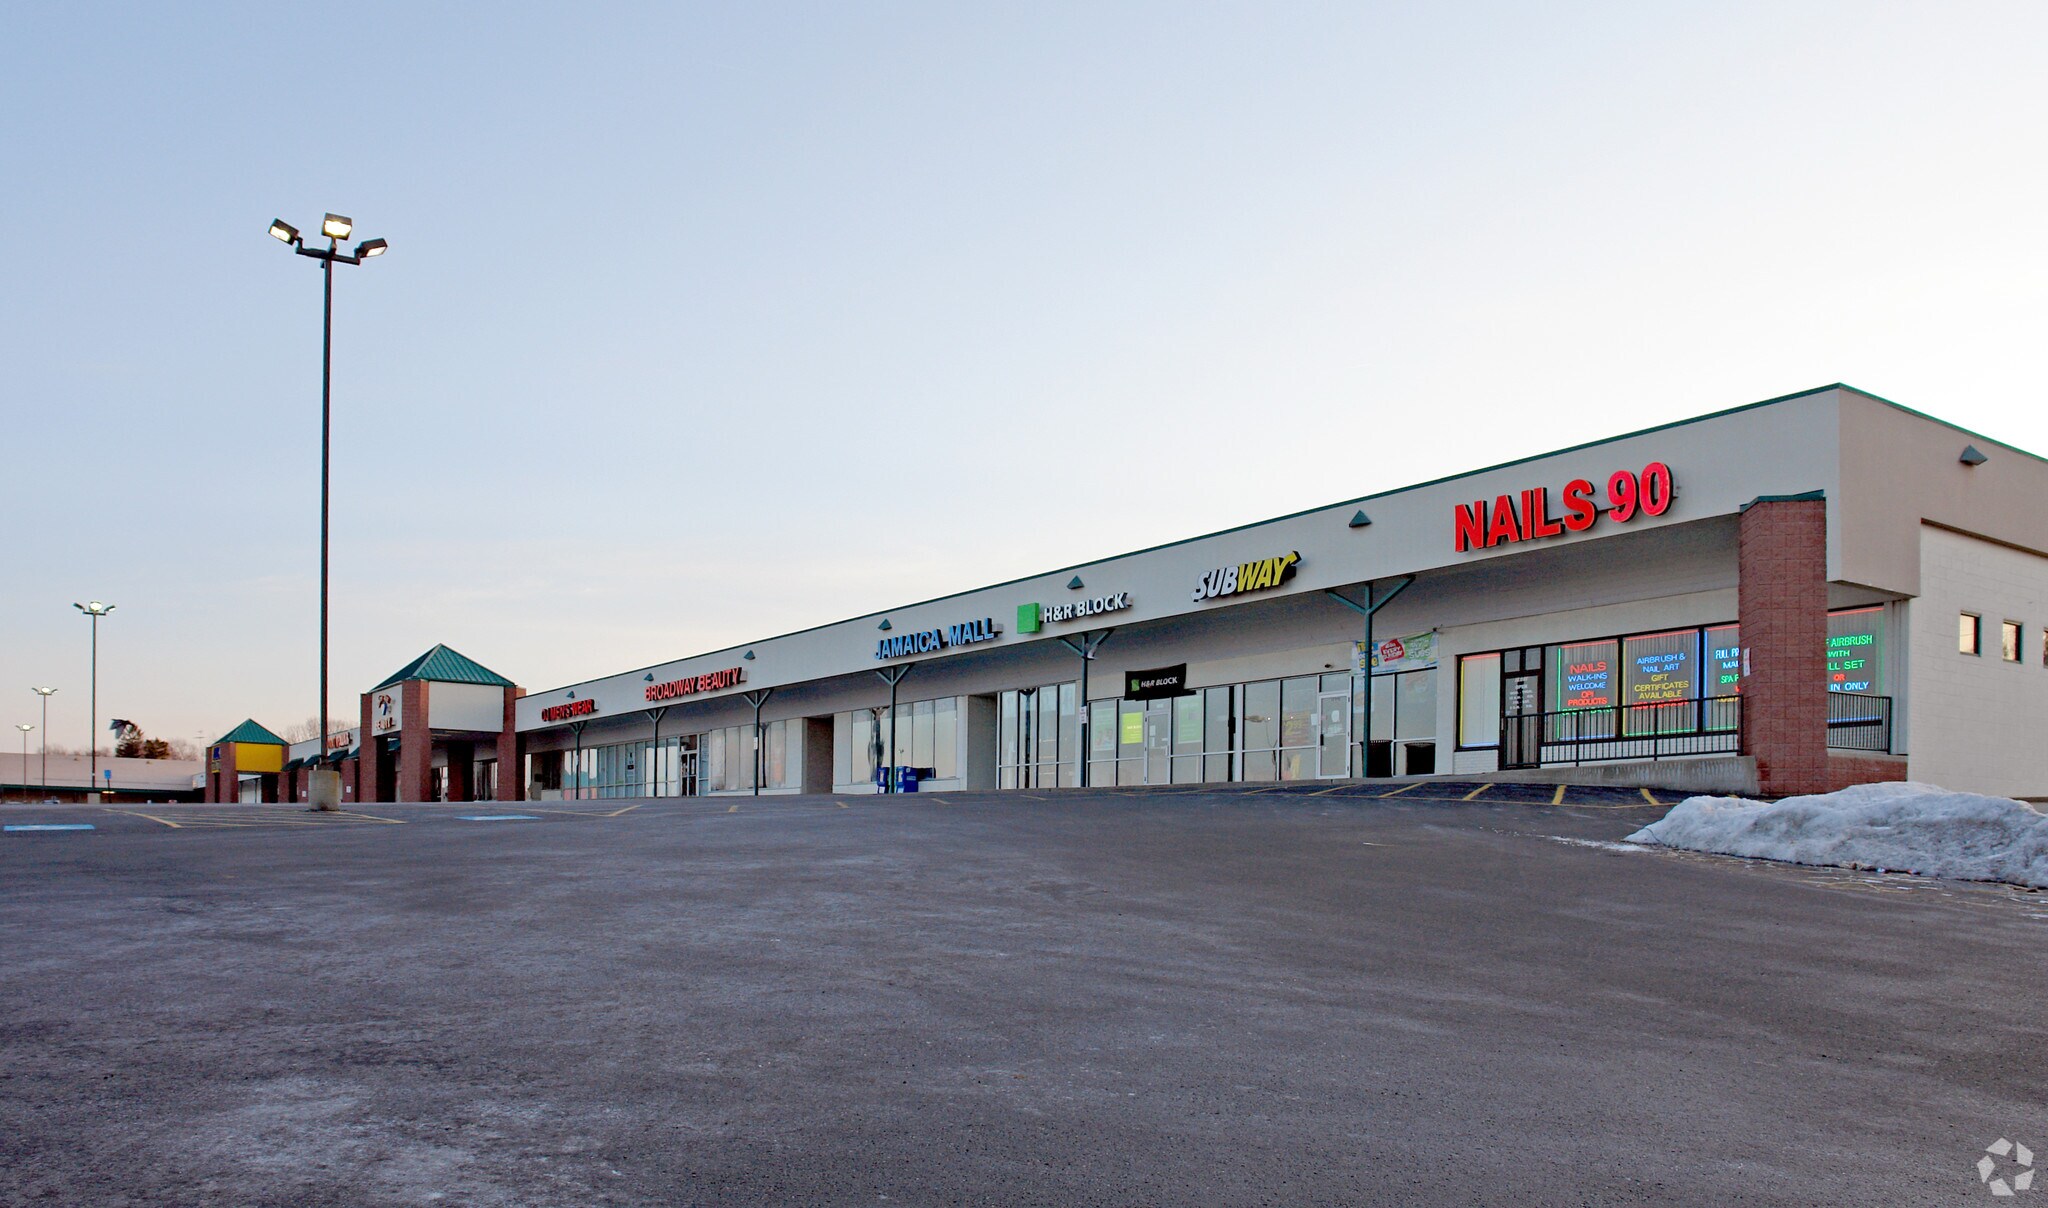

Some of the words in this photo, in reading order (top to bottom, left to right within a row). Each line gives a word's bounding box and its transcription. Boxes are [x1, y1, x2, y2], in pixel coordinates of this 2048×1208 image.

[1454, 478, 1596, 553] NAILS
[1607, 461, 1673, 523] 90
[1191, 551, 1300, 600] SUBWAY
[1044, 603, 1073, 623] H&R
[1076, 592, 1127, 617] BLOCK
[875, 628, 942, 660] JAMAICA
[948, 617, 994, 647] MALL
[1830, 634, 1873, 648] AIRBRUSH
[1636, 654, 1678, 665] AIRBRUSH
[1679, 652, 1686, 661] &
[1715, 649, 1729, 660] FULL
[1731, 647, 1740, 658] PR
[1827, 650, 1850, 658] WITH
[1569, 661, 1607, 675] NAILS
[1642, 665, 1661, 673] NAIL
[1663, 662, 1680, 671] ART
[1828, 660, 1841, 671] LL
[1844, 659, 1866, 670] SET
[1155, 676, 1178, 686] BLOCK
[1567, 672, 1608, 683] WALK-INS
[1651, 673, 1669, 682] GIFT
[1720, 674, 1734, 684] SPA
[1833, 673, 1846, 682] OR
[644, 678, 698, 702] BROADWAY
[698, 667, 742, 692] BEAUTY
[1568, 681, 1607, 691] WELCOME
[1634, 680, 1690, 692] CERTIFICATES
[1844, 681, 1870, 692] ONLY
[1638, 690, 1683, 700] AVAILABLE
[571, 698, 595, 717] WEAR
[1567, 697, 1608, 707] PRODUCTS
